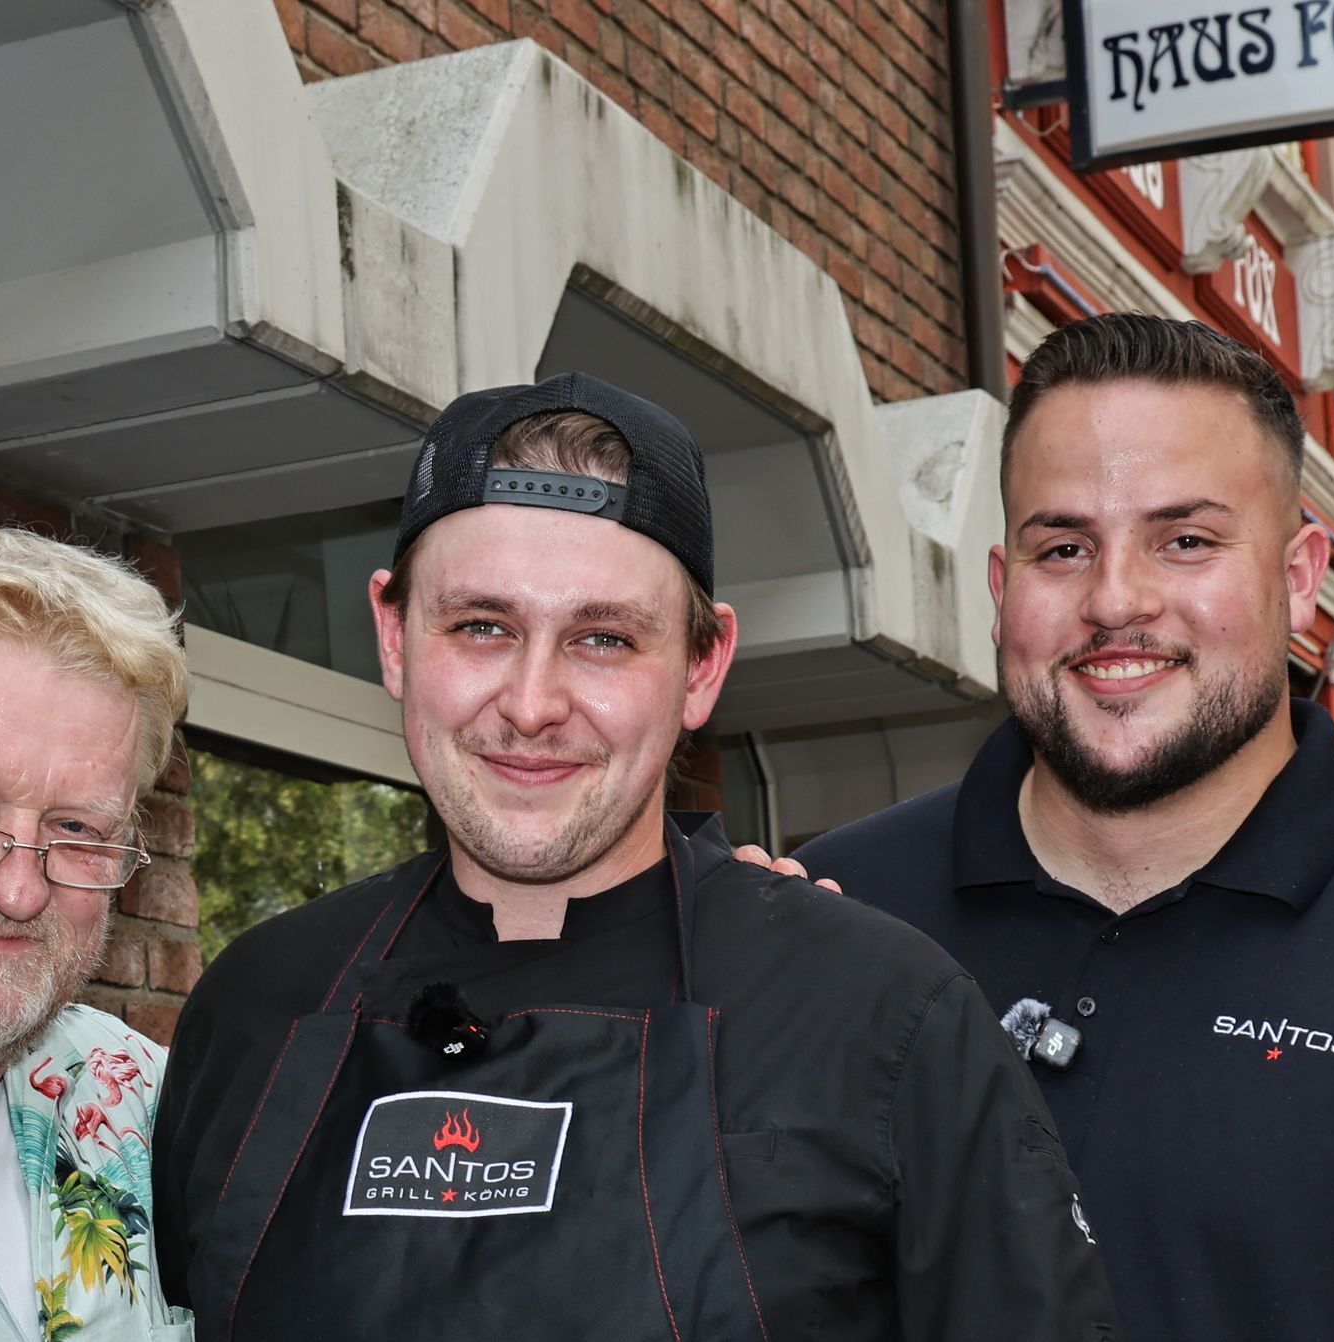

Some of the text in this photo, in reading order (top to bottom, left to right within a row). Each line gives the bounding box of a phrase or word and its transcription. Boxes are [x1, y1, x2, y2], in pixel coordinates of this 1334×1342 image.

[368, 1151, 537, 1184] SANTOS
[365, 1186, 530, 1202] GRILL KÖNIG
